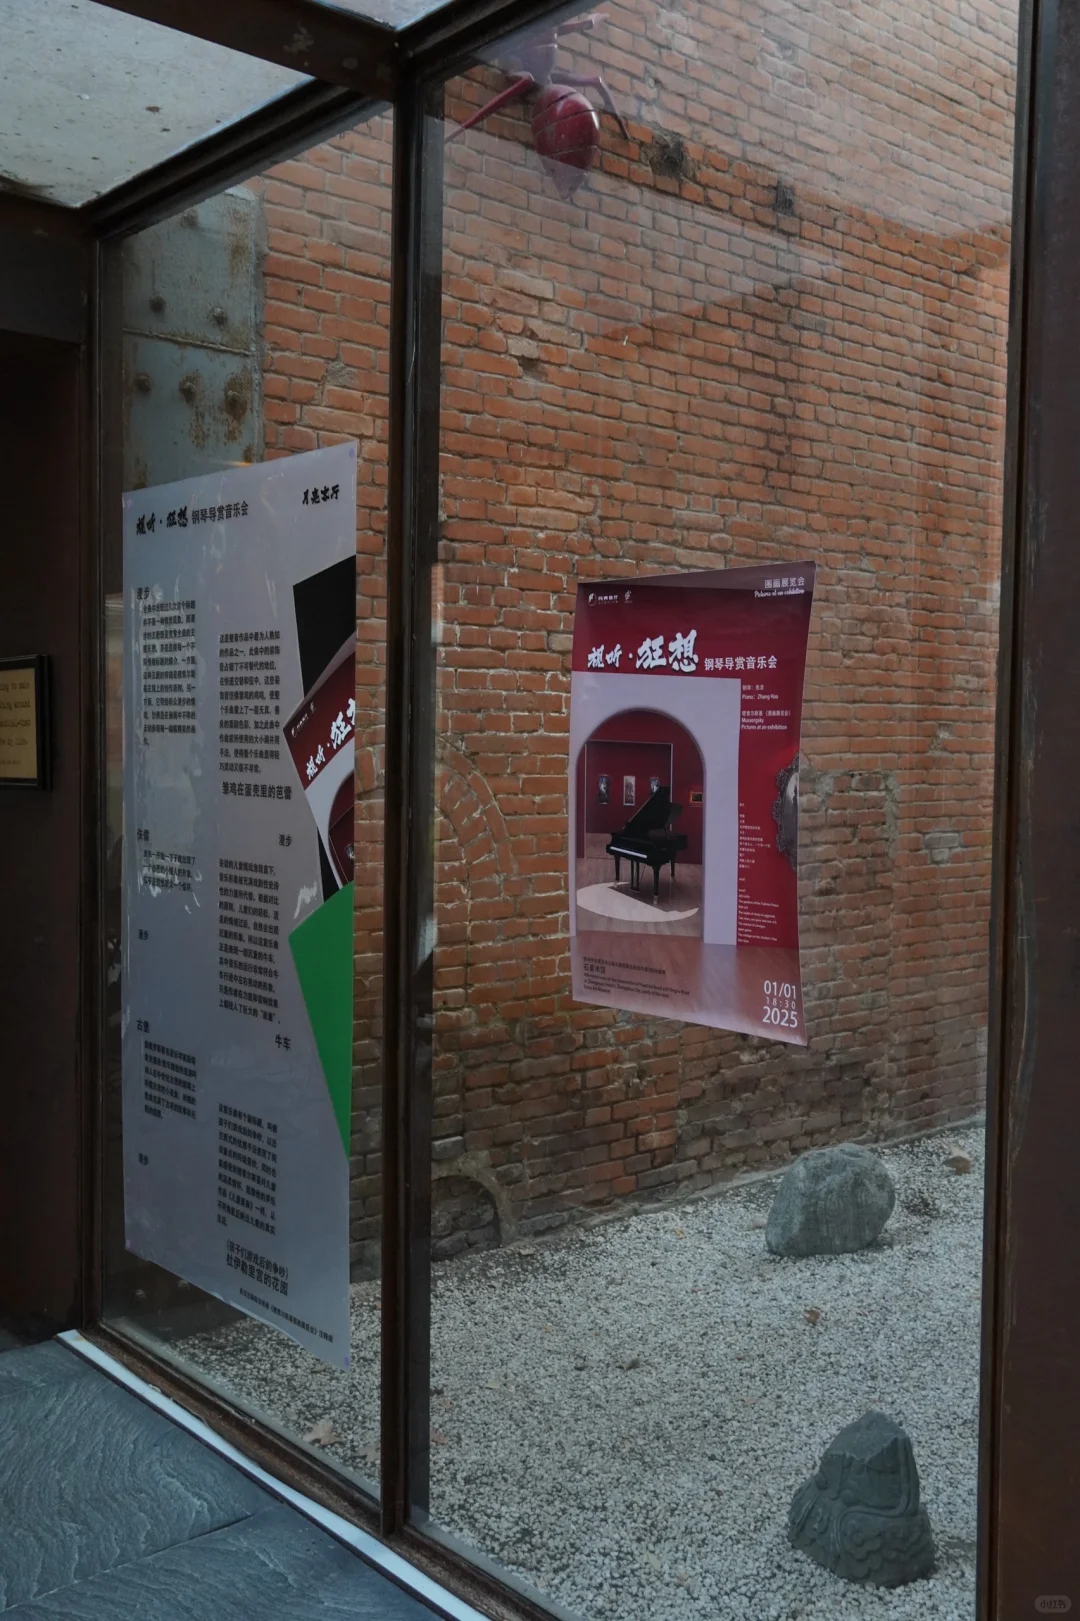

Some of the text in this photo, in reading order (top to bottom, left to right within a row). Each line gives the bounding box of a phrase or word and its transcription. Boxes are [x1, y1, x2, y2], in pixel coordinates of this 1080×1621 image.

[302, 484, 340, 505] 月亮客厅
[191, 501, 249, 524] 钢琴导赏音乐会
[764, 576, 805, 589] 图画展览会
[704, 655, 778, 671] 钢琴导赏音乐会
[222, 782, 292, 800] 雏鸡在蛋壳里的芭蕾
[278, 834, 292, 847] 漫步
[764, 980, 796, 999] 01/01
[766, 996, 796, 1010] 18:30
[762, 1006, 798, 1028] 2025
[275, 1033, 291, 1050] 牛车
[226, 1253, 289, 1296] 杜伊勒里宫的花园
